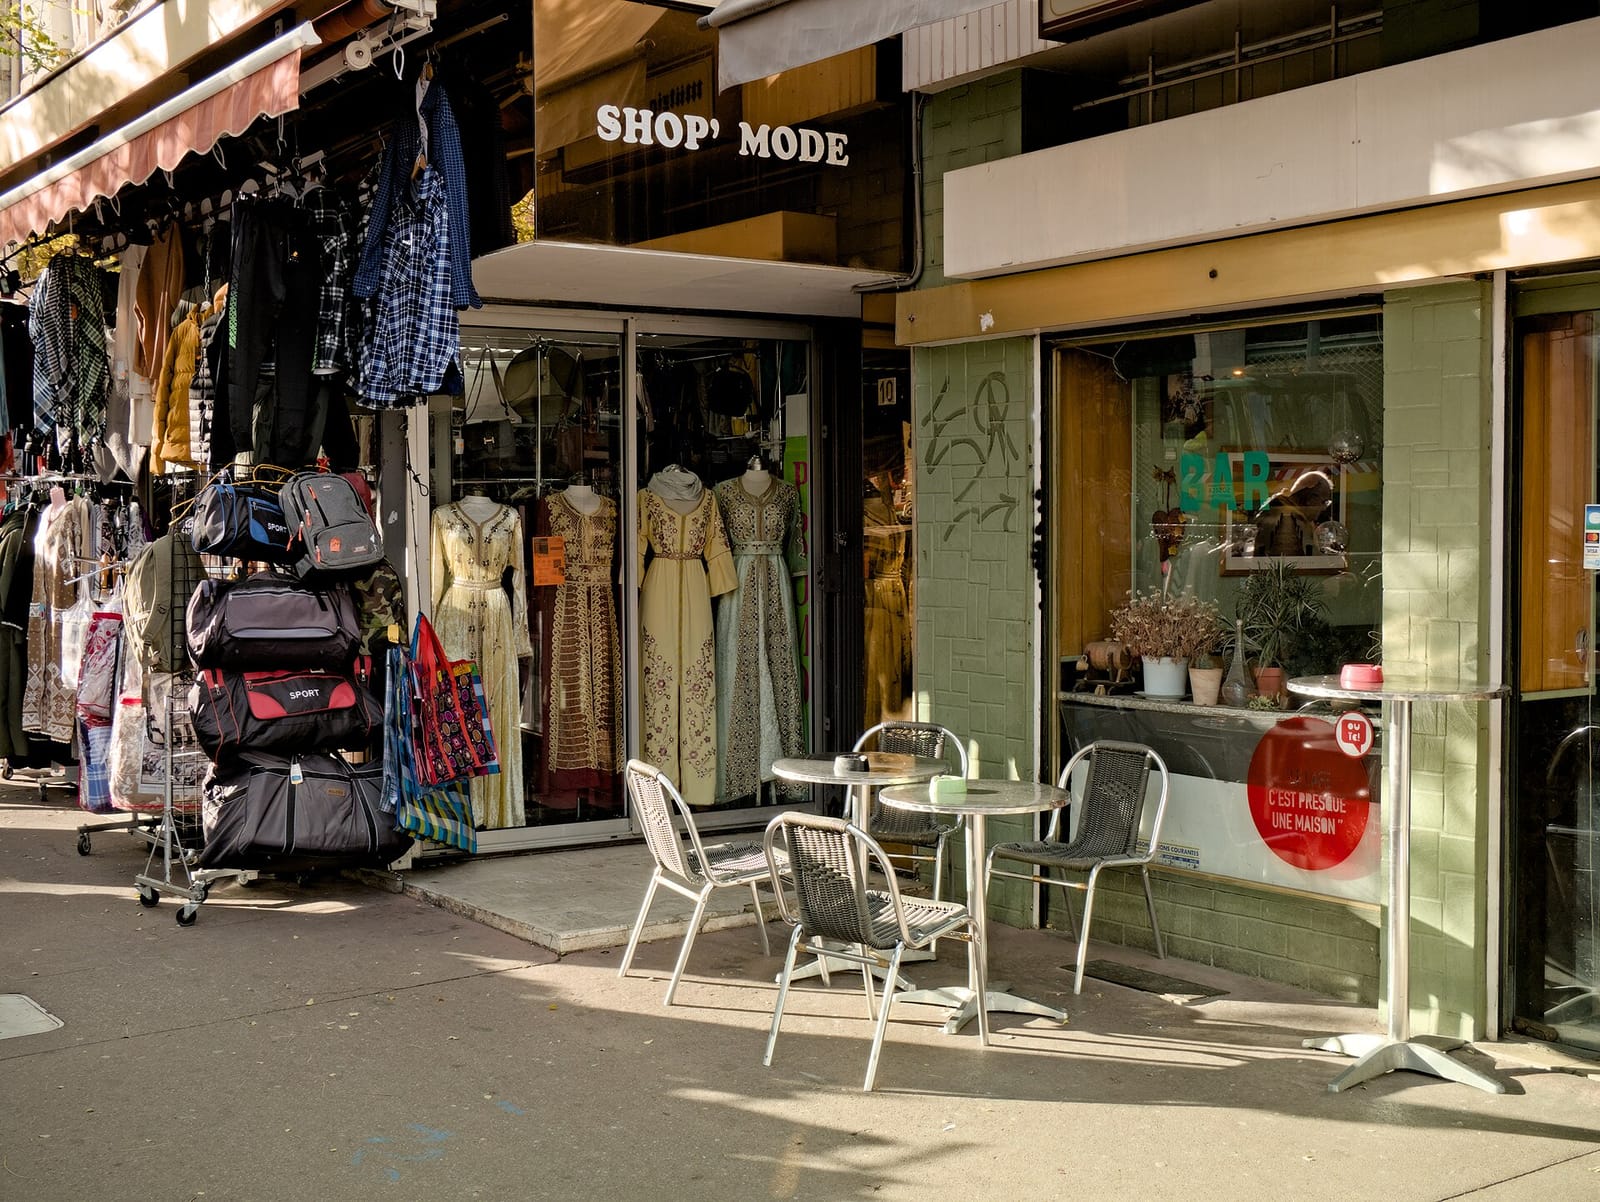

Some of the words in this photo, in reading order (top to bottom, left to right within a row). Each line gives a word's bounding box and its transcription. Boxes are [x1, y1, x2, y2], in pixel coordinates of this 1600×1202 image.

[738, 121, 850, 167] MODE
[879, 380, 893, 404] 10
[1180, 450, 1271, 512] BAR
[267, 522, 288, 534] SPORT
[289, 688, 320, 701] SPORT
[1268, 789, 1296, 808] C'EST
[1298, 791, 1347, 814] PRESQUE
[1271, 811, 1293, 830] UNE
[1294, 813, 1336, 836] MAISON
[1170, 846, 1199, 857] COURANTES
